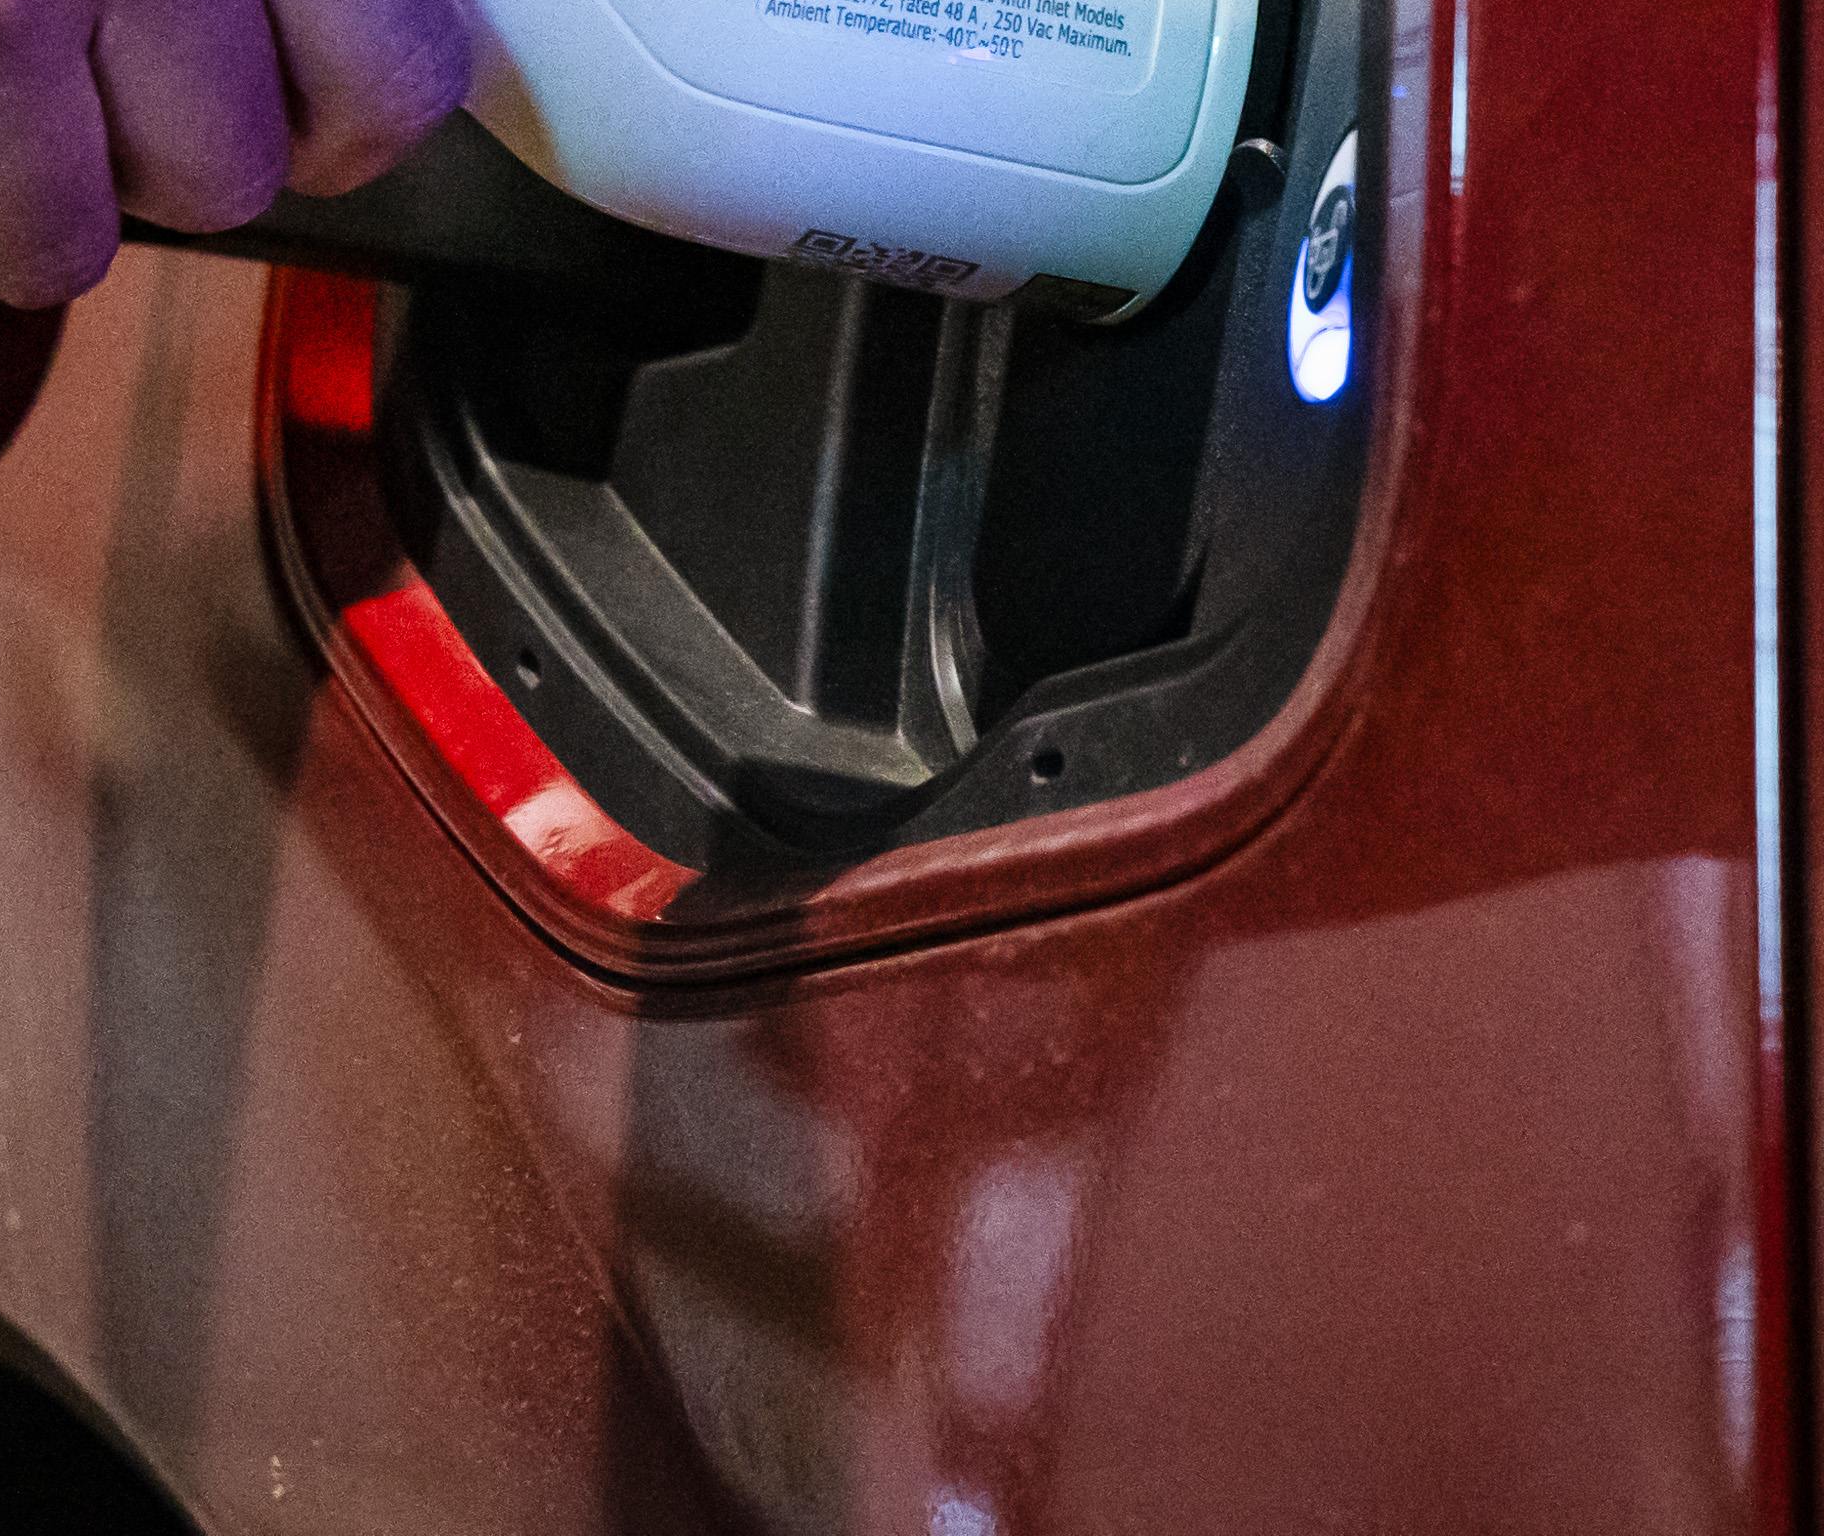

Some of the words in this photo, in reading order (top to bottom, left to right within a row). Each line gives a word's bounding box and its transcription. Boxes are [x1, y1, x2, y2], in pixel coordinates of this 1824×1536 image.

[944, 2, 963, 21] 48
[993, 10, 1023, 33] 250
[1027, 16, 1054, 40] Vac
[1057, 24, 1132, 57] Maximum.
[1074, 1, 1125, 30] Models
